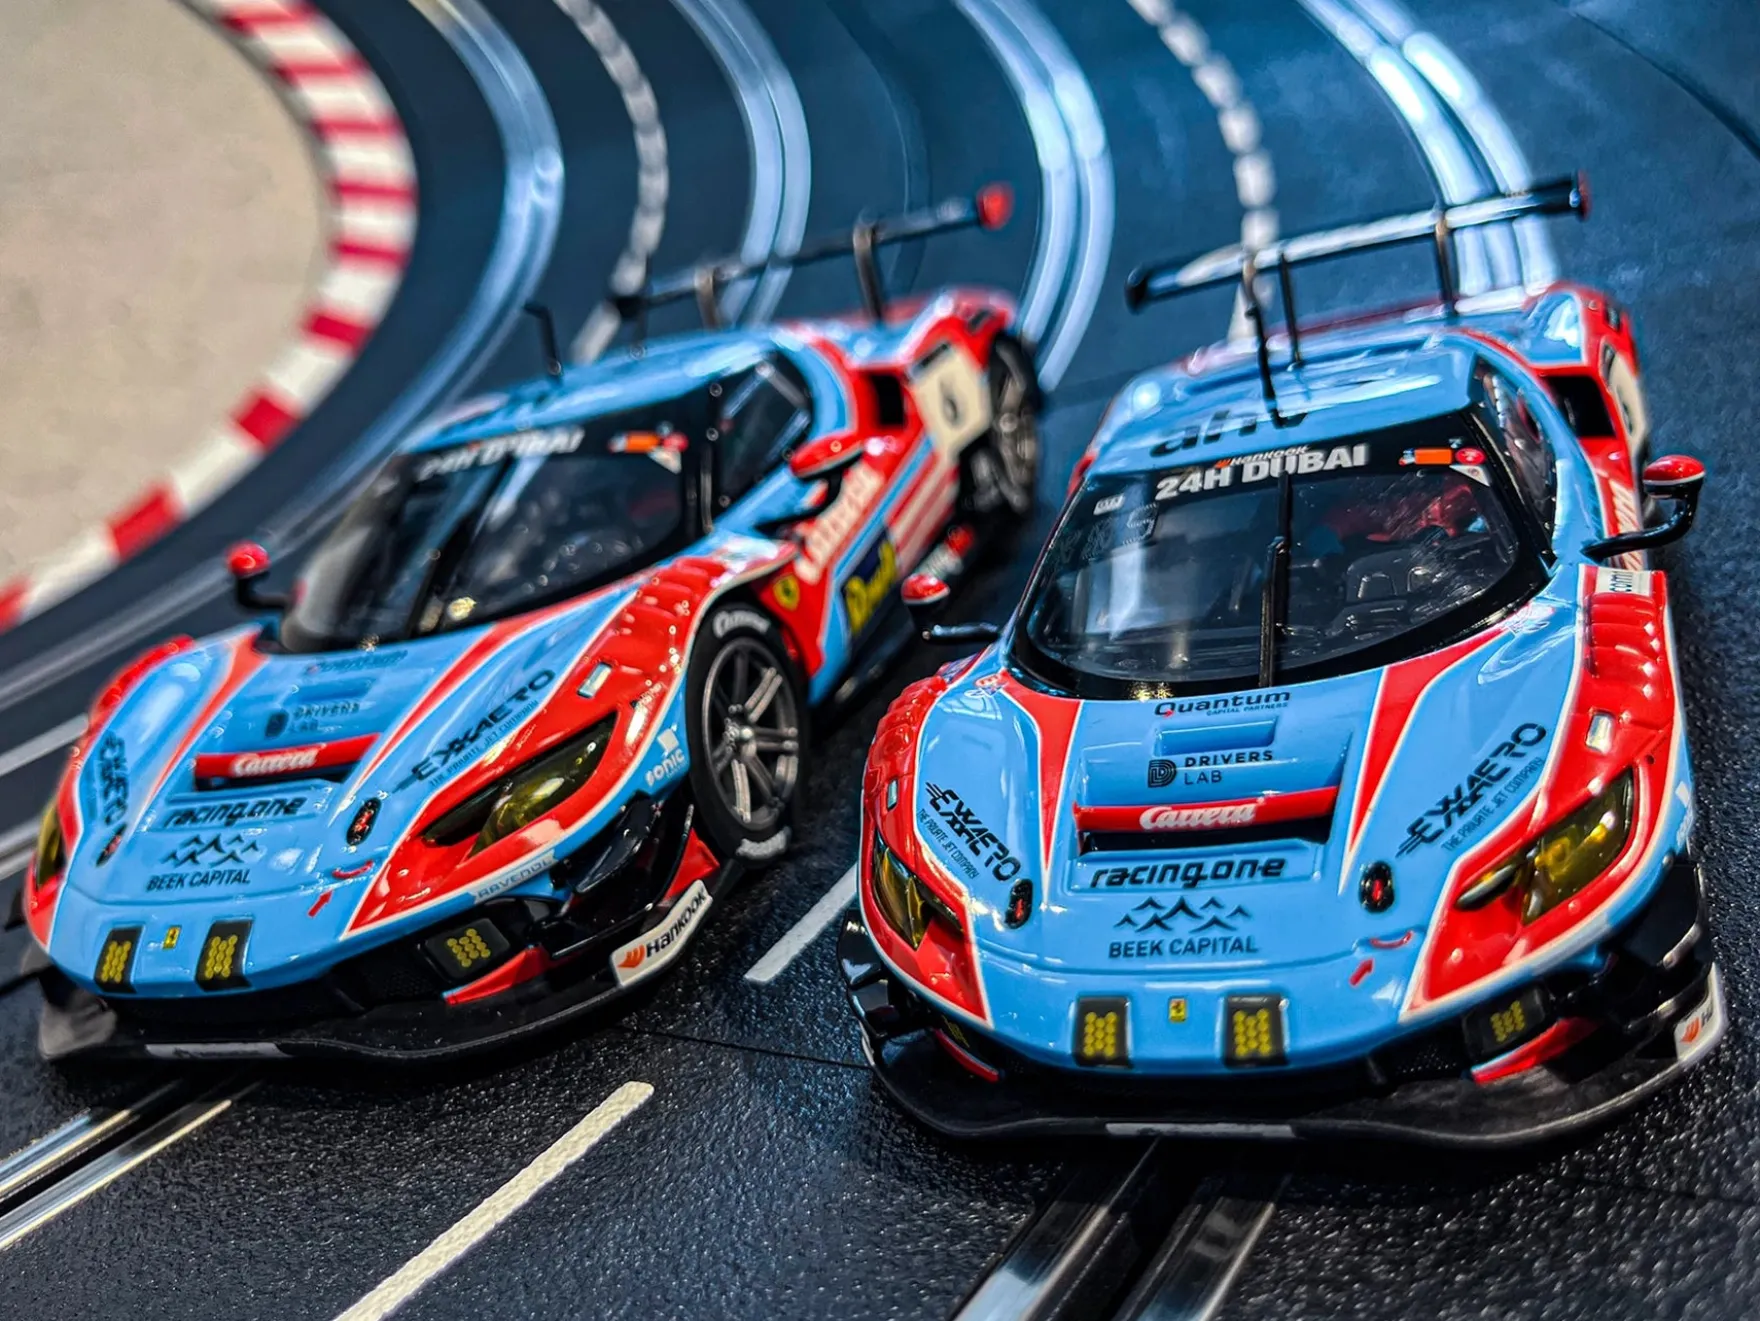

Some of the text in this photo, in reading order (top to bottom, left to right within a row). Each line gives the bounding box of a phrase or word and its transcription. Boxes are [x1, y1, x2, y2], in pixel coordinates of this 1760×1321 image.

[1155, 443, 1370, 500] 24H DUBAI
[1155, 692, 1290, 716] Quantum
[1206, 702, 1288, 716] CAPITAL PARTNERS
[1185, 750, 1273, 768] DRIVERS
[1184, 769, 1222, 785] LAB
[1139, 804, 1258, 830] Carrera
[146, 868, 251, 892] BEEK CAPITAL
[1108, 935, 1259, 959] BEEK CAPITAL
